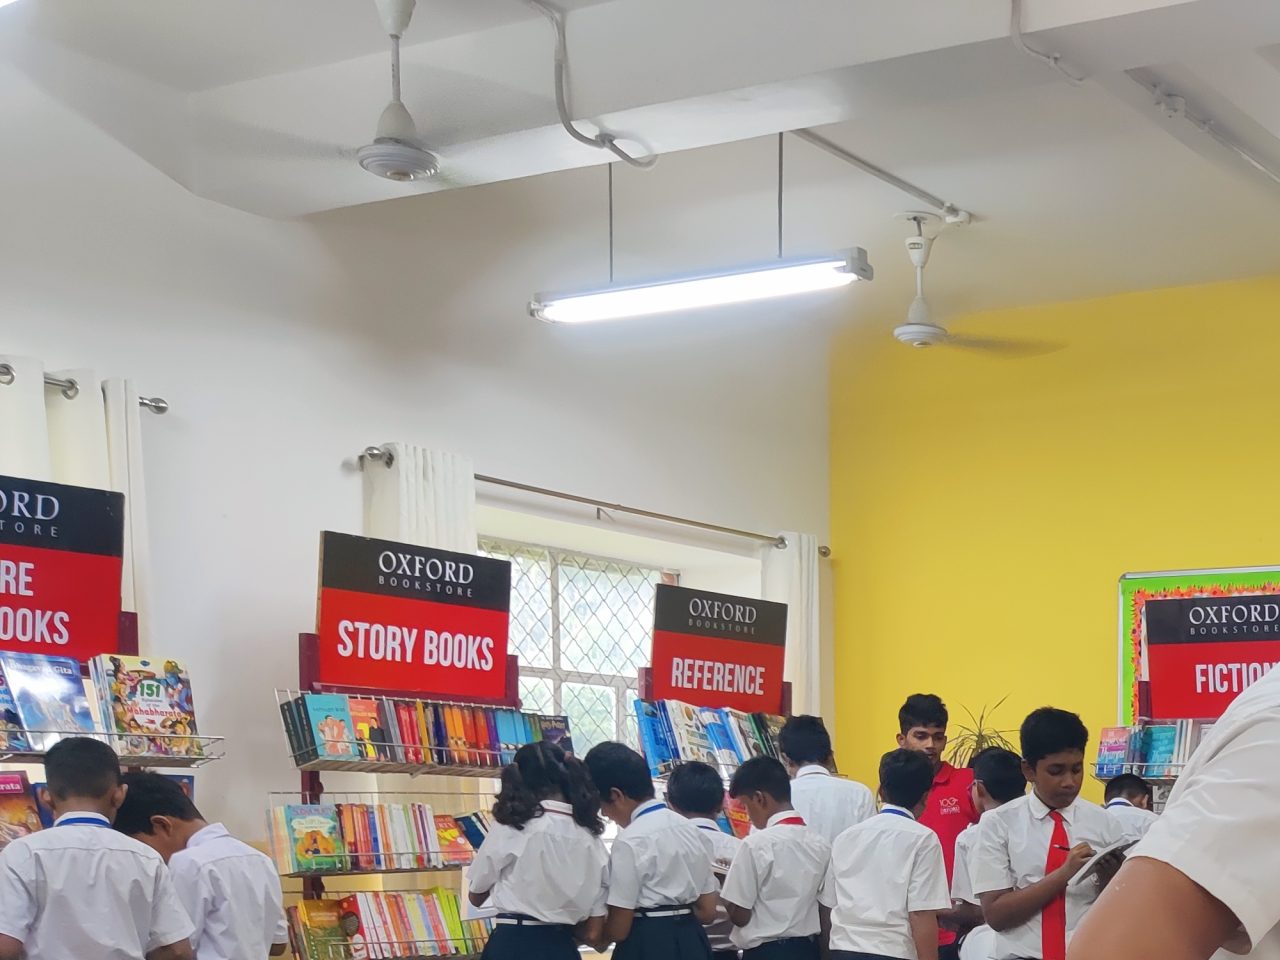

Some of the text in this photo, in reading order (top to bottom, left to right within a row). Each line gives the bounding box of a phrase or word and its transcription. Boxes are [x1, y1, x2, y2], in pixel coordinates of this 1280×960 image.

[378, 550, 474, 584] OXFORD
[378, 575, 473, 598] BOOKSTORE
[688, 597, 757, 624] OXFORD
[1189, 603, 1280, 625] OXFORD
[688, 618, 756, 635] BOOKSTORE
[1190, 624, 1279, 636] BOOKSTORE
[337, 619, 494, 671] STORY BOOKS
[671, 656, 766, 696] REFERENCE
[140, 683, 161, 698] 151
